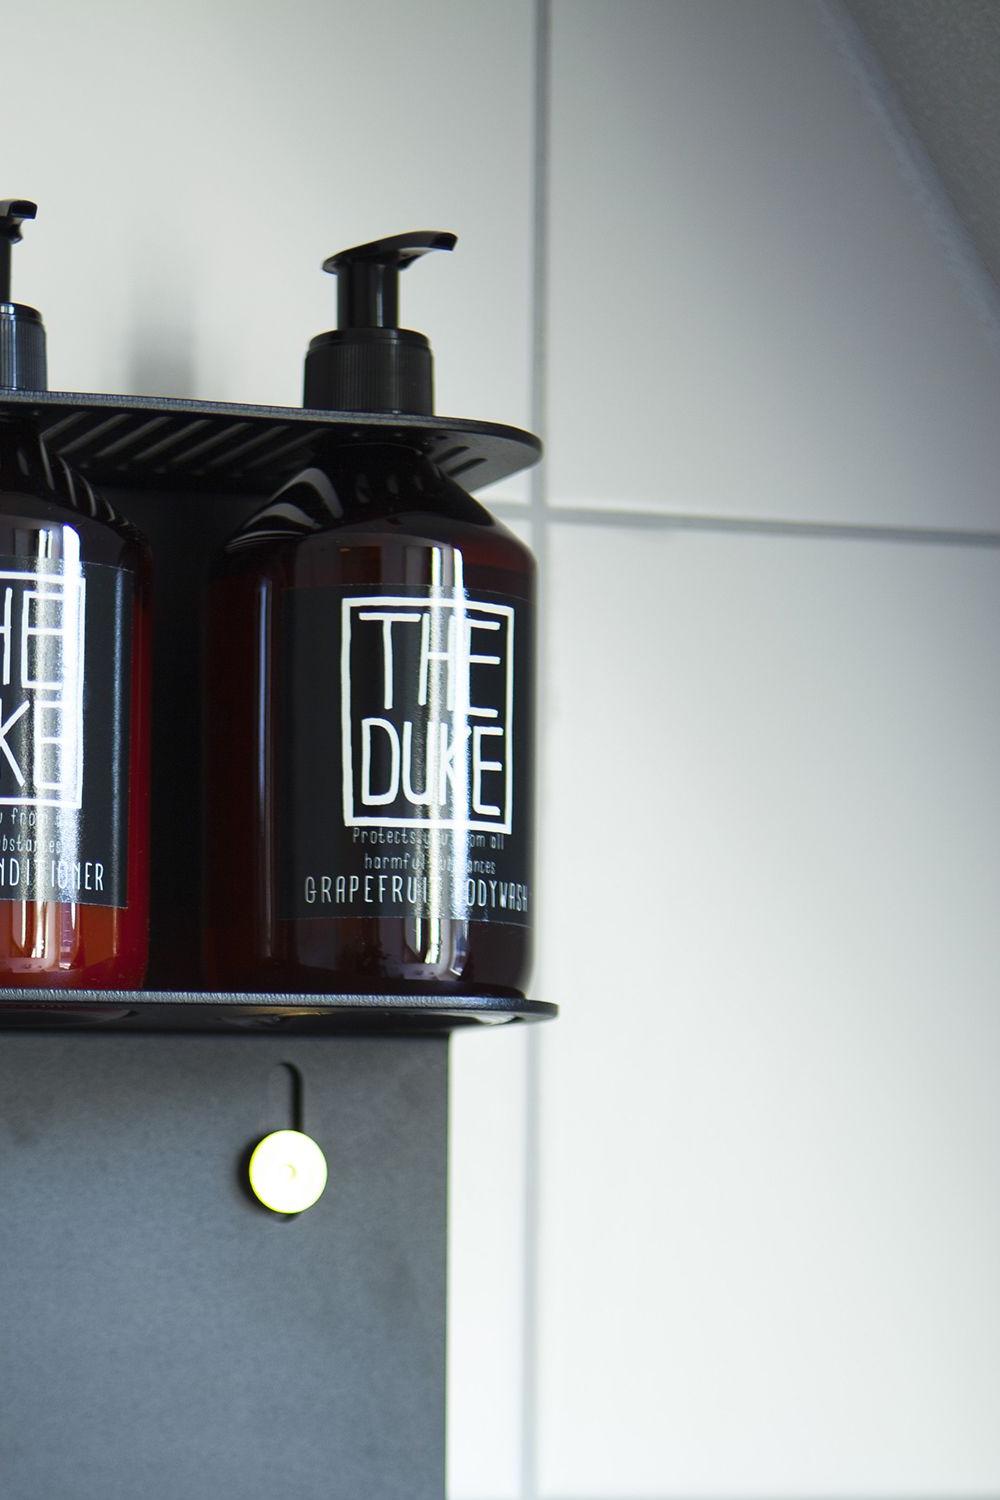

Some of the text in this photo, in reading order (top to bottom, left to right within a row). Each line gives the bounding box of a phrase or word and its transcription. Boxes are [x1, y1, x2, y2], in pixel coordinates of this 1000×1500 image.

[358, 612, 501, 718] THE
[360, 717, 504, 816] DUKE
[352, 827, 415, 845] Protects
[455, 877, 530, 914] ODYWASH
